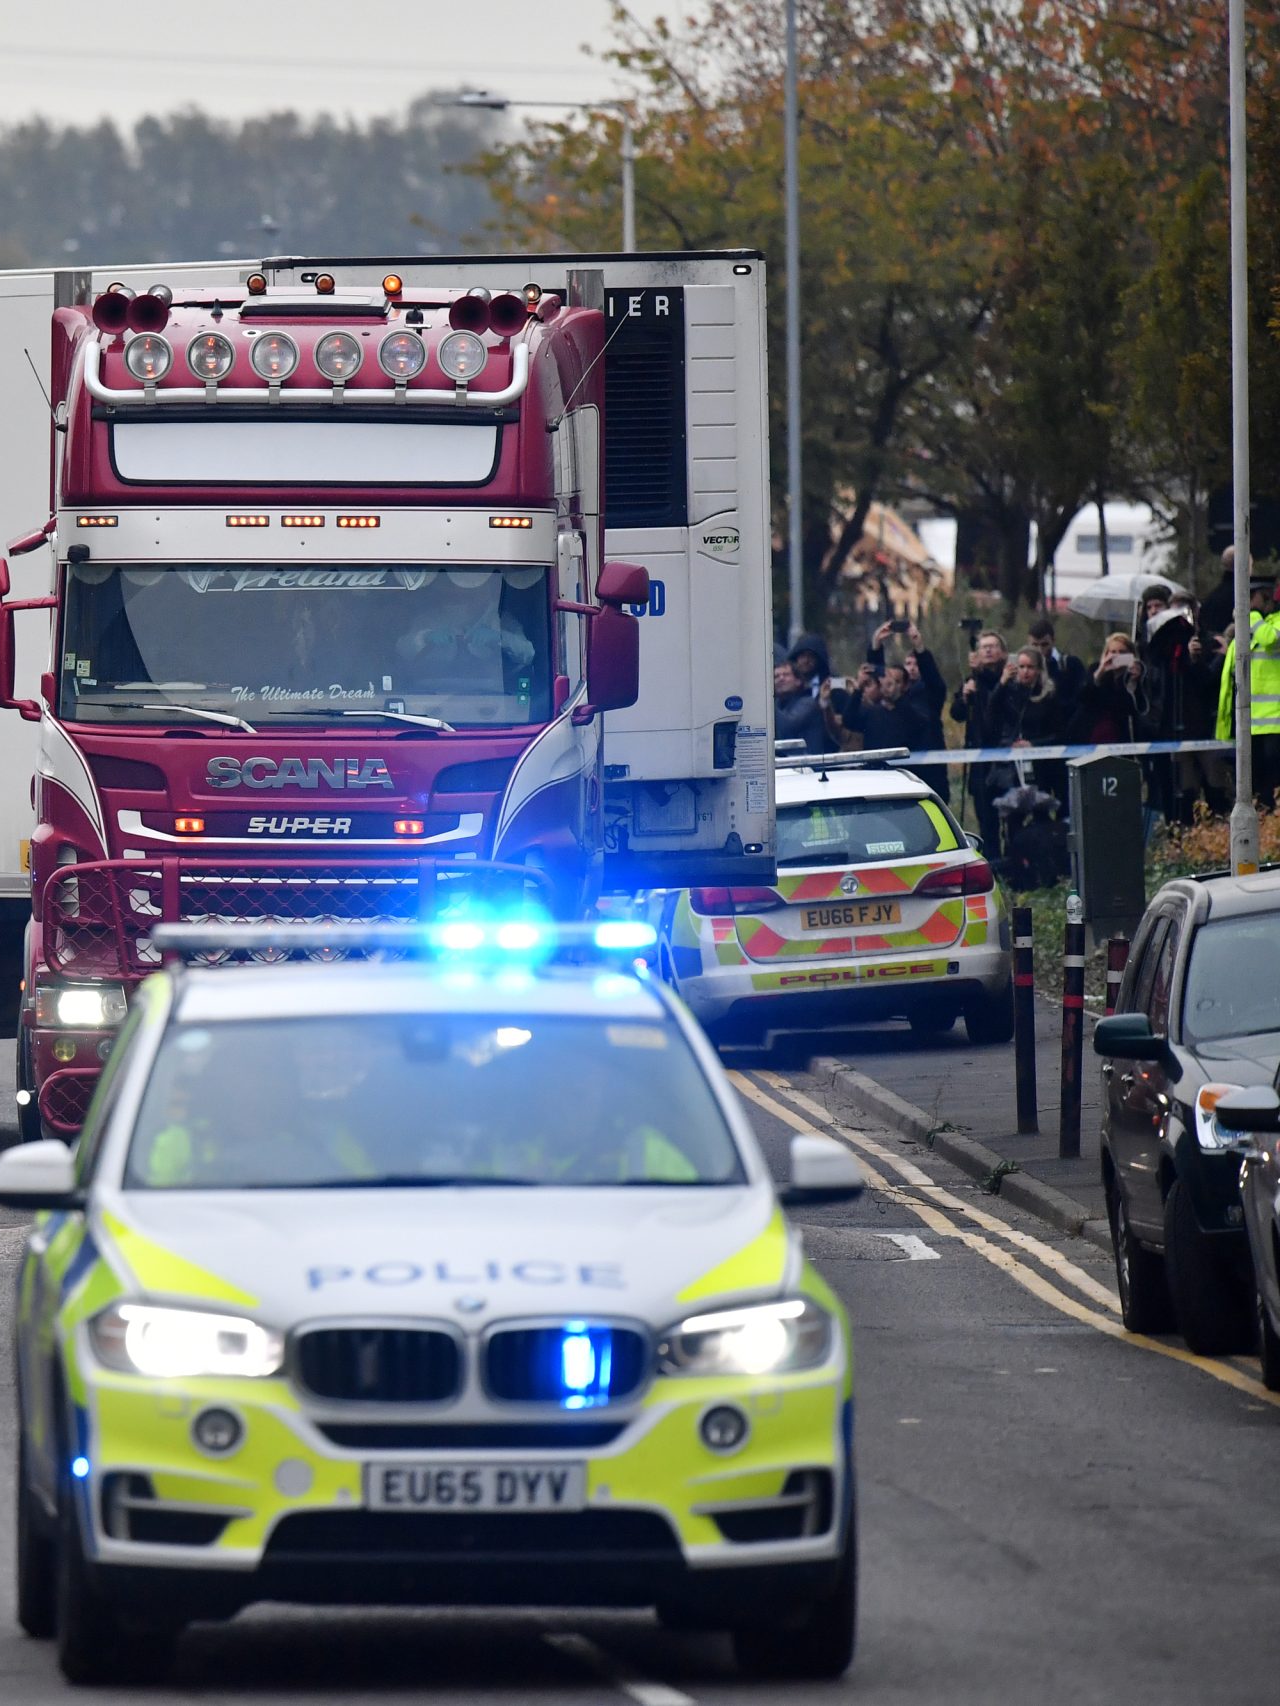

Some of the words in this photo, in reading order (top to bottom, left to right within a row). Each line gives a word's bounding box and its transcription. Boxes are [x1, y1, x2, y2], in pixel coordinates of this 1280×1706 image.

[703, 536, 740, 544] VECTOR
[231, 687, 255, 702] The
[261, 685, 324, 700] Ultimate
[329, 683, 375, 700] Dream
[206, 757, 395, 789] SCANIA
[1102, 777, 1118, 796] 12
[247, 817, 352, 834] SUPER
[807, 908, 854, 928] EU66
[859, 904, 892, 923] FJY
[780, 964, 934, 985] POLICE
[307, 1260, 626, 1292] POLICE
[382, 1470, 483, 1505] EU65
[495, 1470, 568, 1505] DYV
